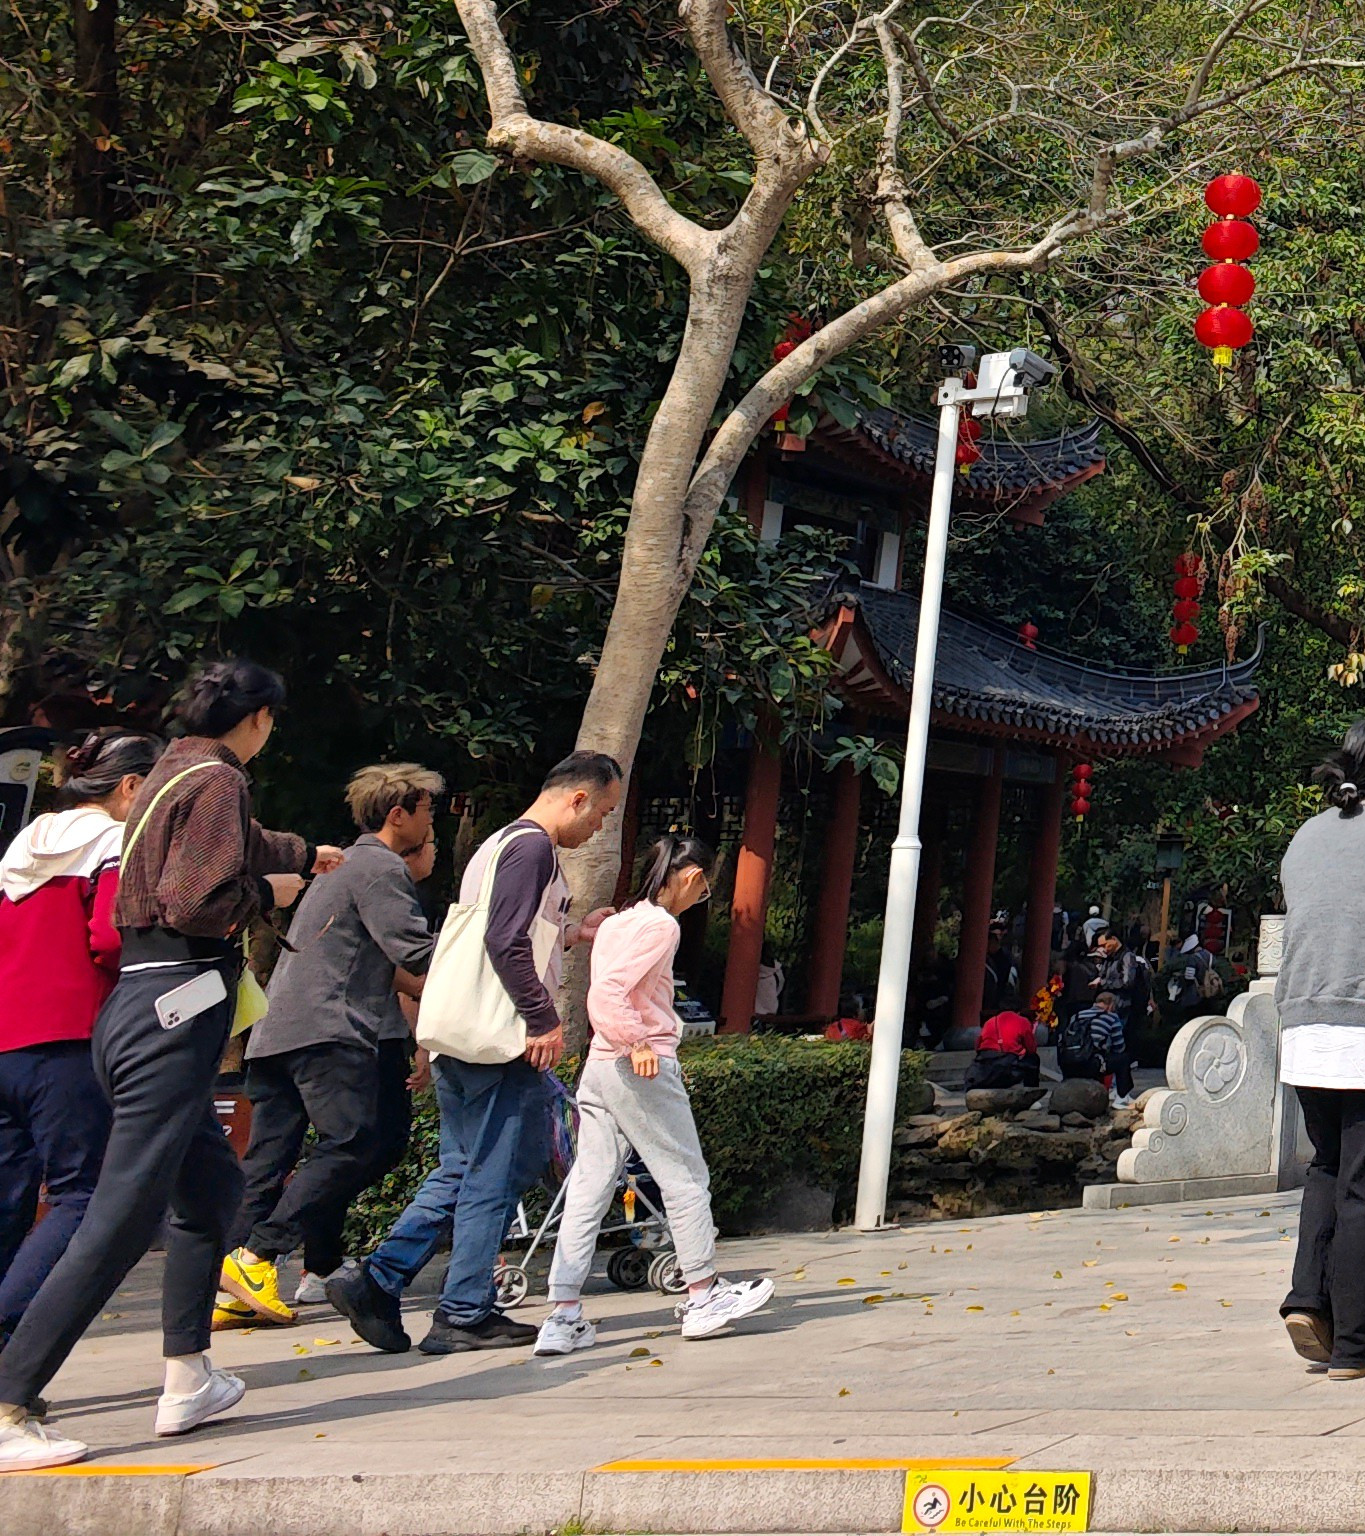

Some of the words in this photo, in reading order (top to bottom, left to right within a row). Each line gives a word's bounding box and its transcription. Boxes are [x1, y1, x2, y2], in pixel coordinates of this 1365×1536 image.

[958, 1482, 1080, 1515] 小心台阶
[955, 1517, 966, 1527] Be
[968, 1517, 1001, 1528] Careful
[1003, 1517, 1024, 1528] With
[1027, 1518, 1044, 1529] The
[1046, 1519, 1072, 1533] Steps
